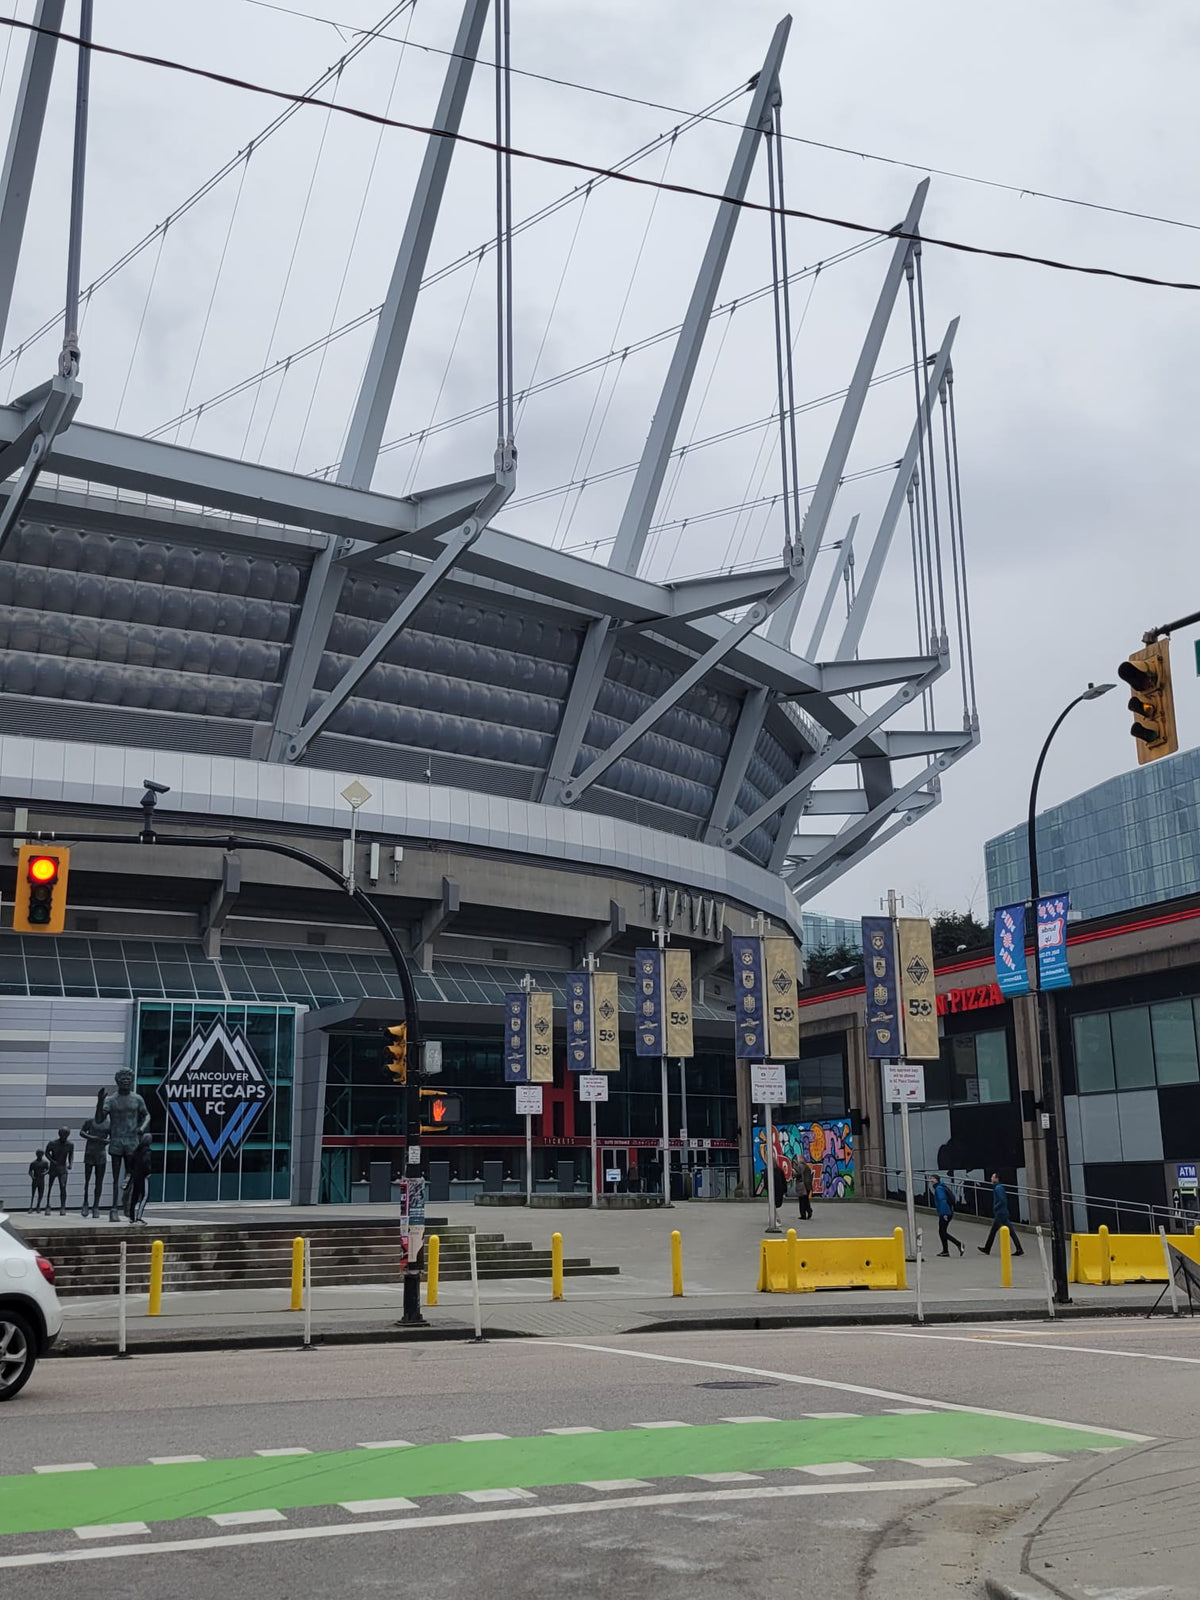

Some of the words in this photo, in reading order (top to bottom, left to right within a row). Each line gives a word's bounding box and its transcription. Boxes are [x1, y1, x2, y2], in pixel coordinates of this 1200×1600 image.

[949, 983, 1005, 1014] PIZZA
[186, 1072, 249, 1081] VANCOUVER
[165, 1084, 266, 1098] WHITECAPS
[206, 1101, 226, 1115] FC
[544, 1137, 575, 1145] TICKETS
[1179, 1166, 1196, 1177] ATM
